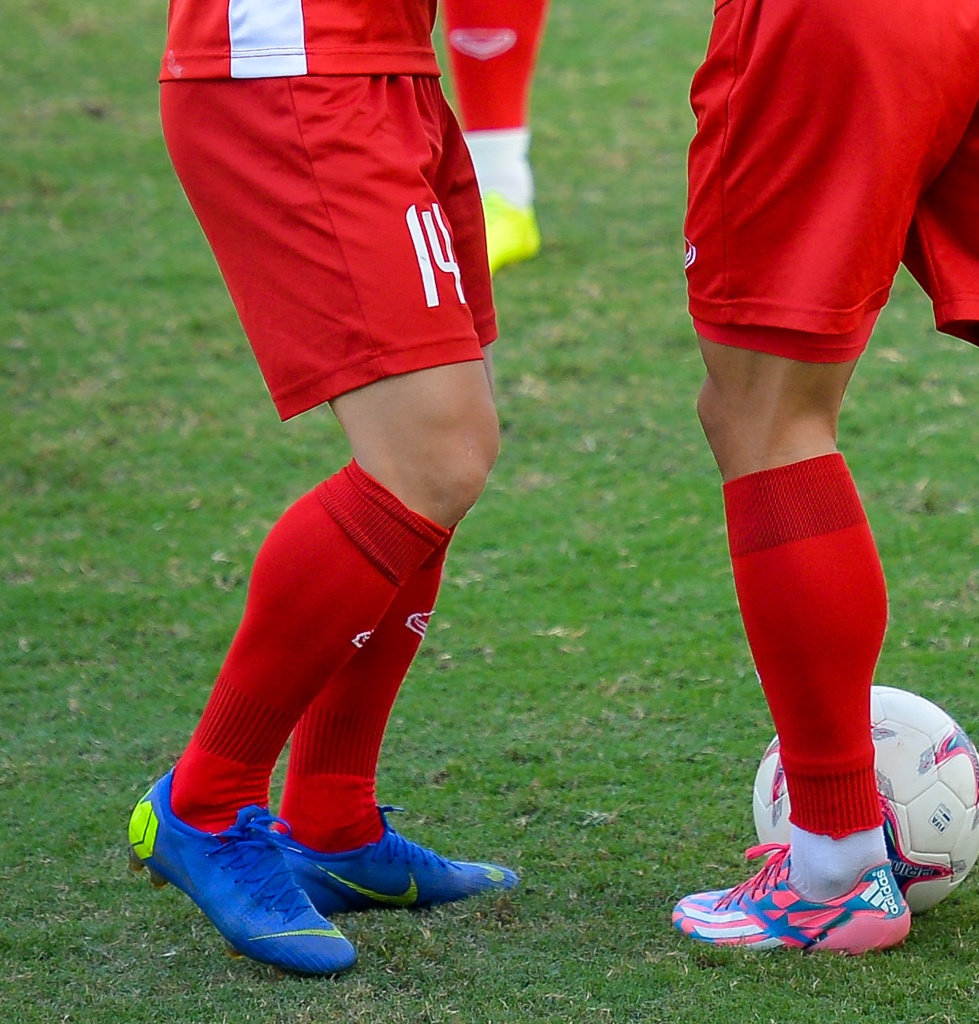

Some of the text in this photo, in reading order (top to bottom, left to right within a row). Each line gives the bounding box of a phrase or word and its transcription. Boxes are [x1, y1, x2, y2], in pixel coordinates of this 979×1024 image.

[405, 203, 467, 308] 14
[931, 816, 946, 833] FIFA
[876, 869, 900, 915] adidas
